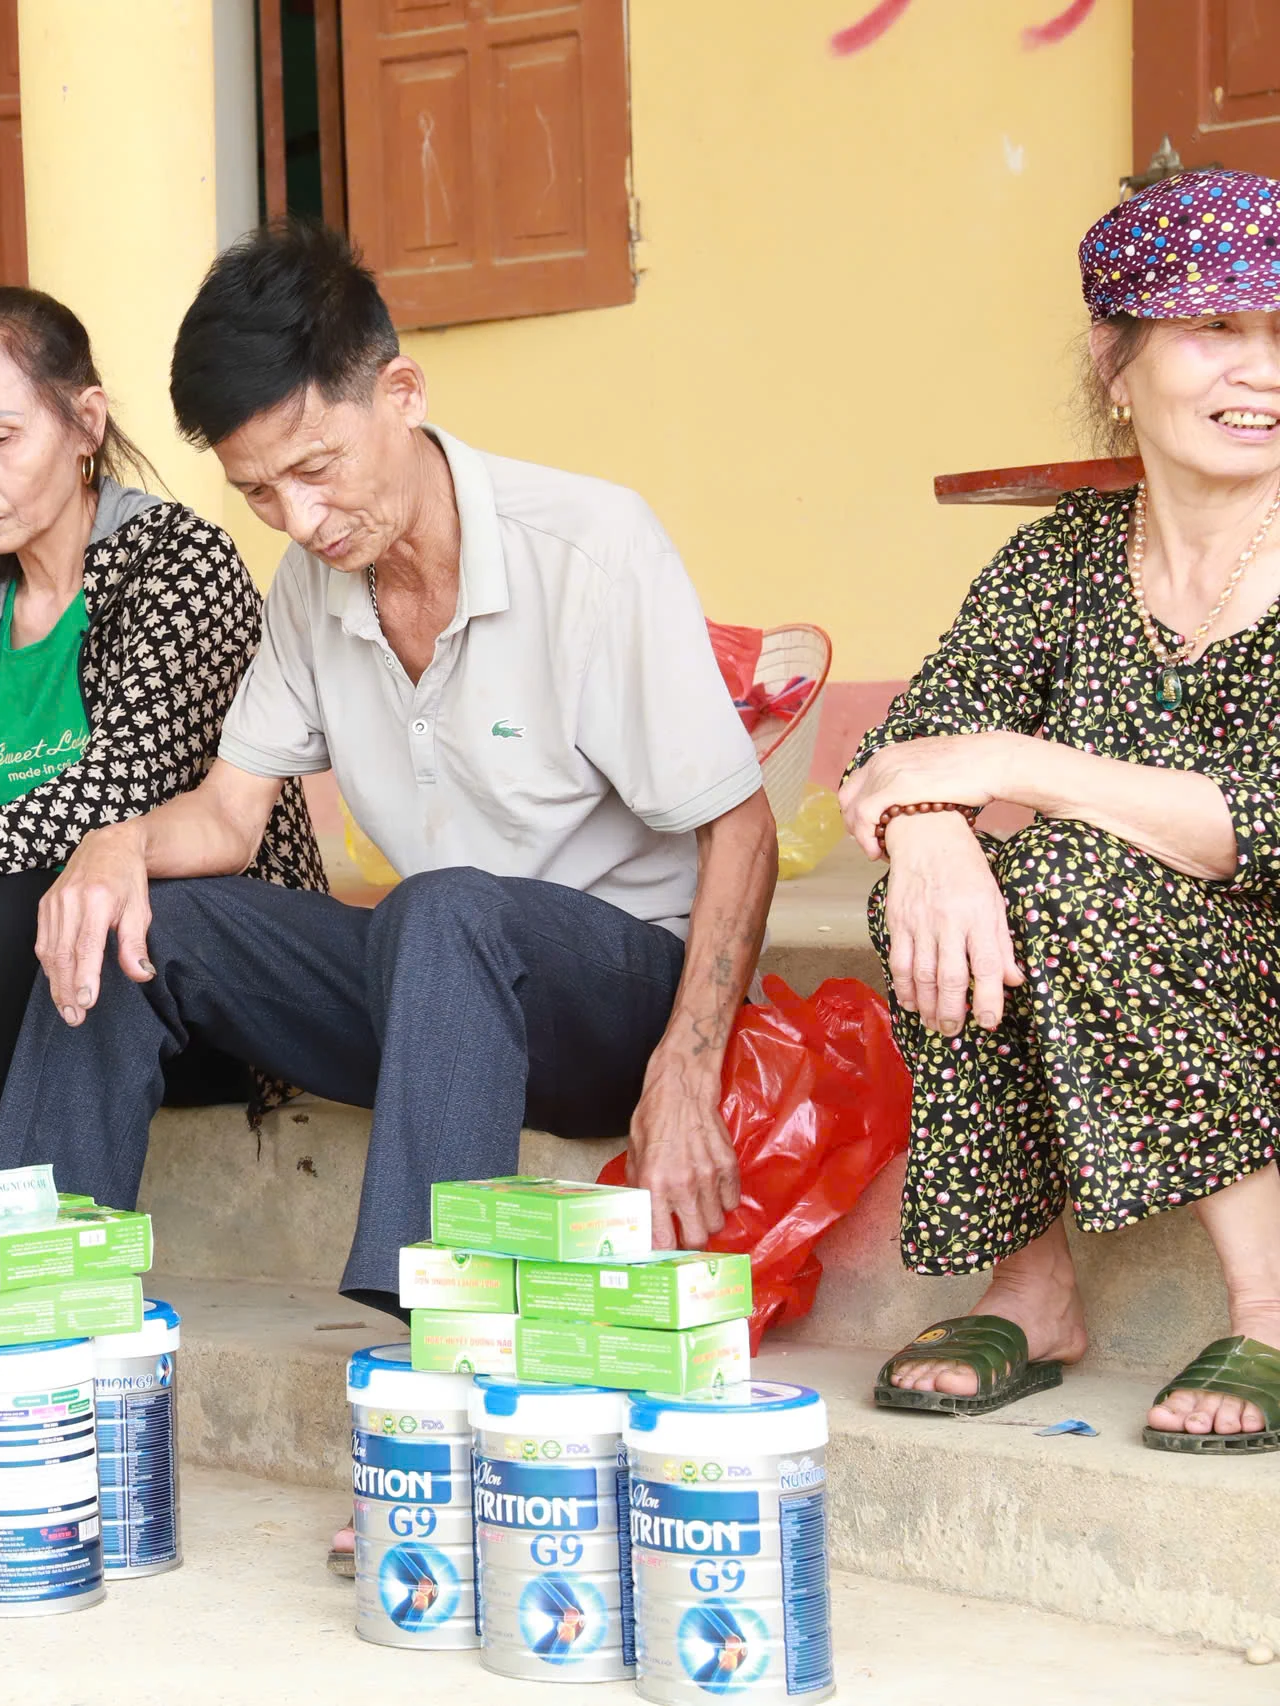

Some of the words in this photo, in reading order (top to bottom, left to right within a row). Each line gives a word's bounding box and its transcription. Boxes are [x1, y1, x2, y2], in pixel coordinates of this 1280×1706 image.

[8, 767, 42, 782] made
[43, 763, 55, 775] in
[421, 1419, 445, 1431] FDA
[566, 1444, 591, 1454] FDA
[728, 1465, 752, 1477] FDA
[388, 1505, 437, 1538] G9
[530, 1533, 584, 1567] G9
[689, 1559, 745, 1593] G9
